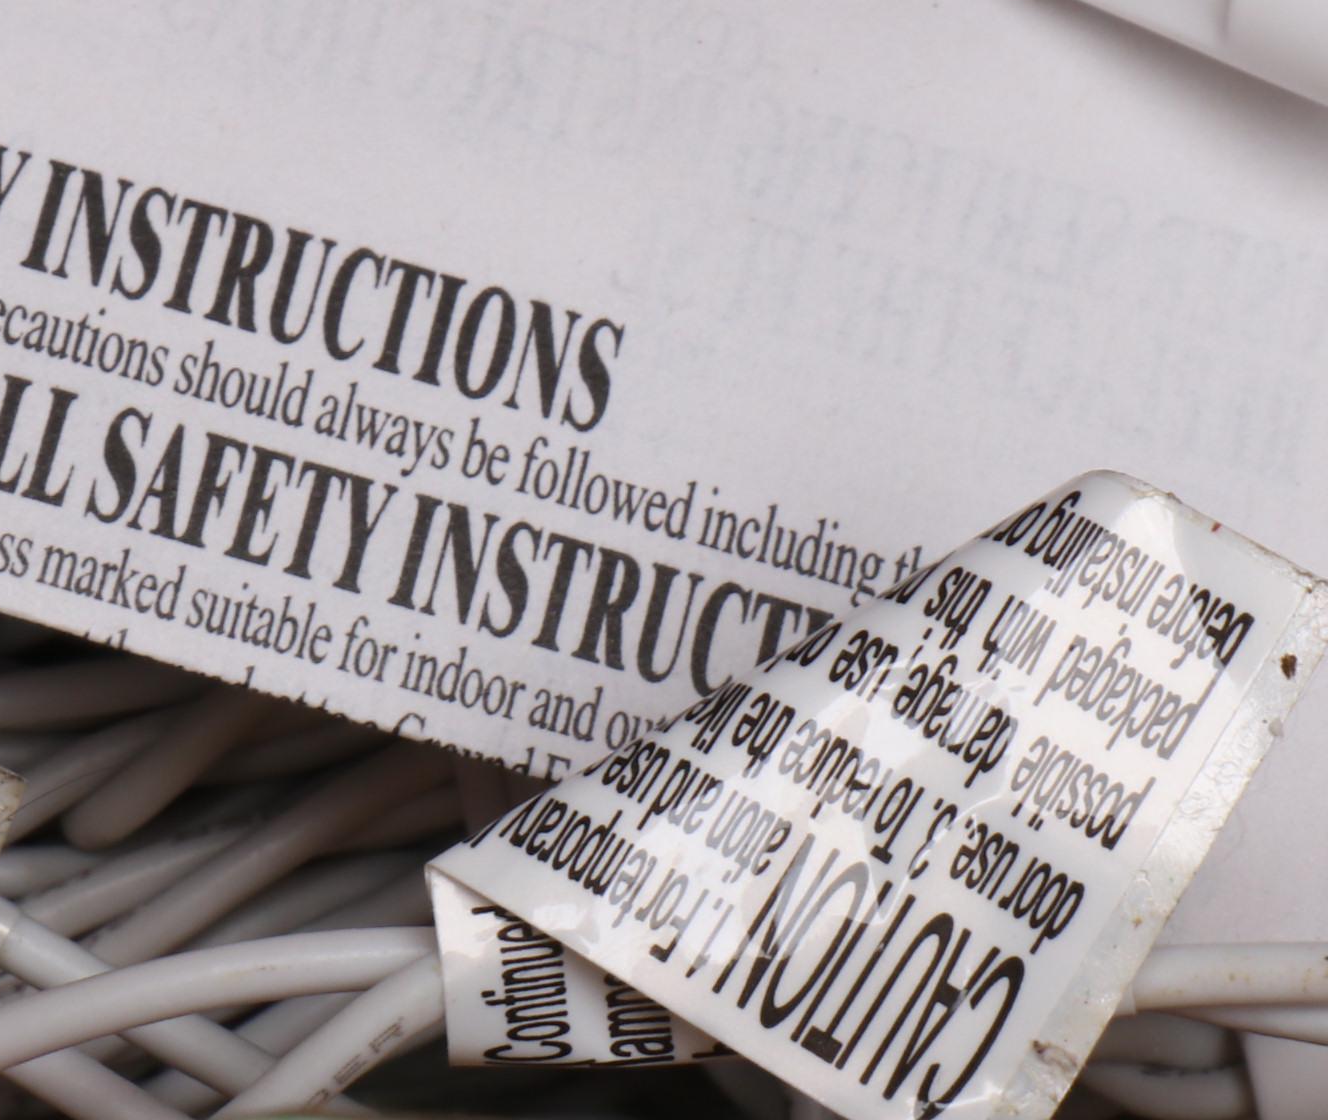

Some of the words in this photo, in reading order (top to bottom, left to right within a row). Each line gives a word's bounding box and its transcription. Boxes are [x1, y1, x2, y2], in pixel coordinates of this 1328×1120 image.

[19, 159, 625, 433] INSTRUCTIONS
[84, 407, 399, 595] SAFETY
[173, 340, 315, 428] should
[314, 381, 455, 478] always
[461, 417, 510, 486] be
[515, 436, 697, 541] followed
[697, 487, 886, 607] including
[923, 565, 993, 650] this
[1023, 490, 1152, 637] installing
[36, 545, 187, 621] marked
[185, 582, 333, 665] suitable
[337, 615, 398, 682] for
[399, 633, 527, 720] indoor
[527, 685, 604, 743] and
[827, 628, 900, 704] use
[975, 593, 1058, 682] with
[1150, 573, 1256, 680] before
[730, 691, 797, 780] the
[890, 644, 1019, 791] damage,
[1035, 632, 1221, 759] packaged
[602, 738, 672, 804] use
[635, 757, 725, 835] and
[778, 718, 894, 822] reduce
[1012, 736, 1155, 851] possible
[497, 797, 658, 929] temporary
[868, 776, 927, 867] To
[908, 797, 958, 880] 3.
[948, 813, 1021, 902] use.
[633, 867, 710, 965] For
[684, 897, 735, 980] 1.
[996, 856, 1086, 957] door
[712, 833, 1025, 1120] CAUTION
